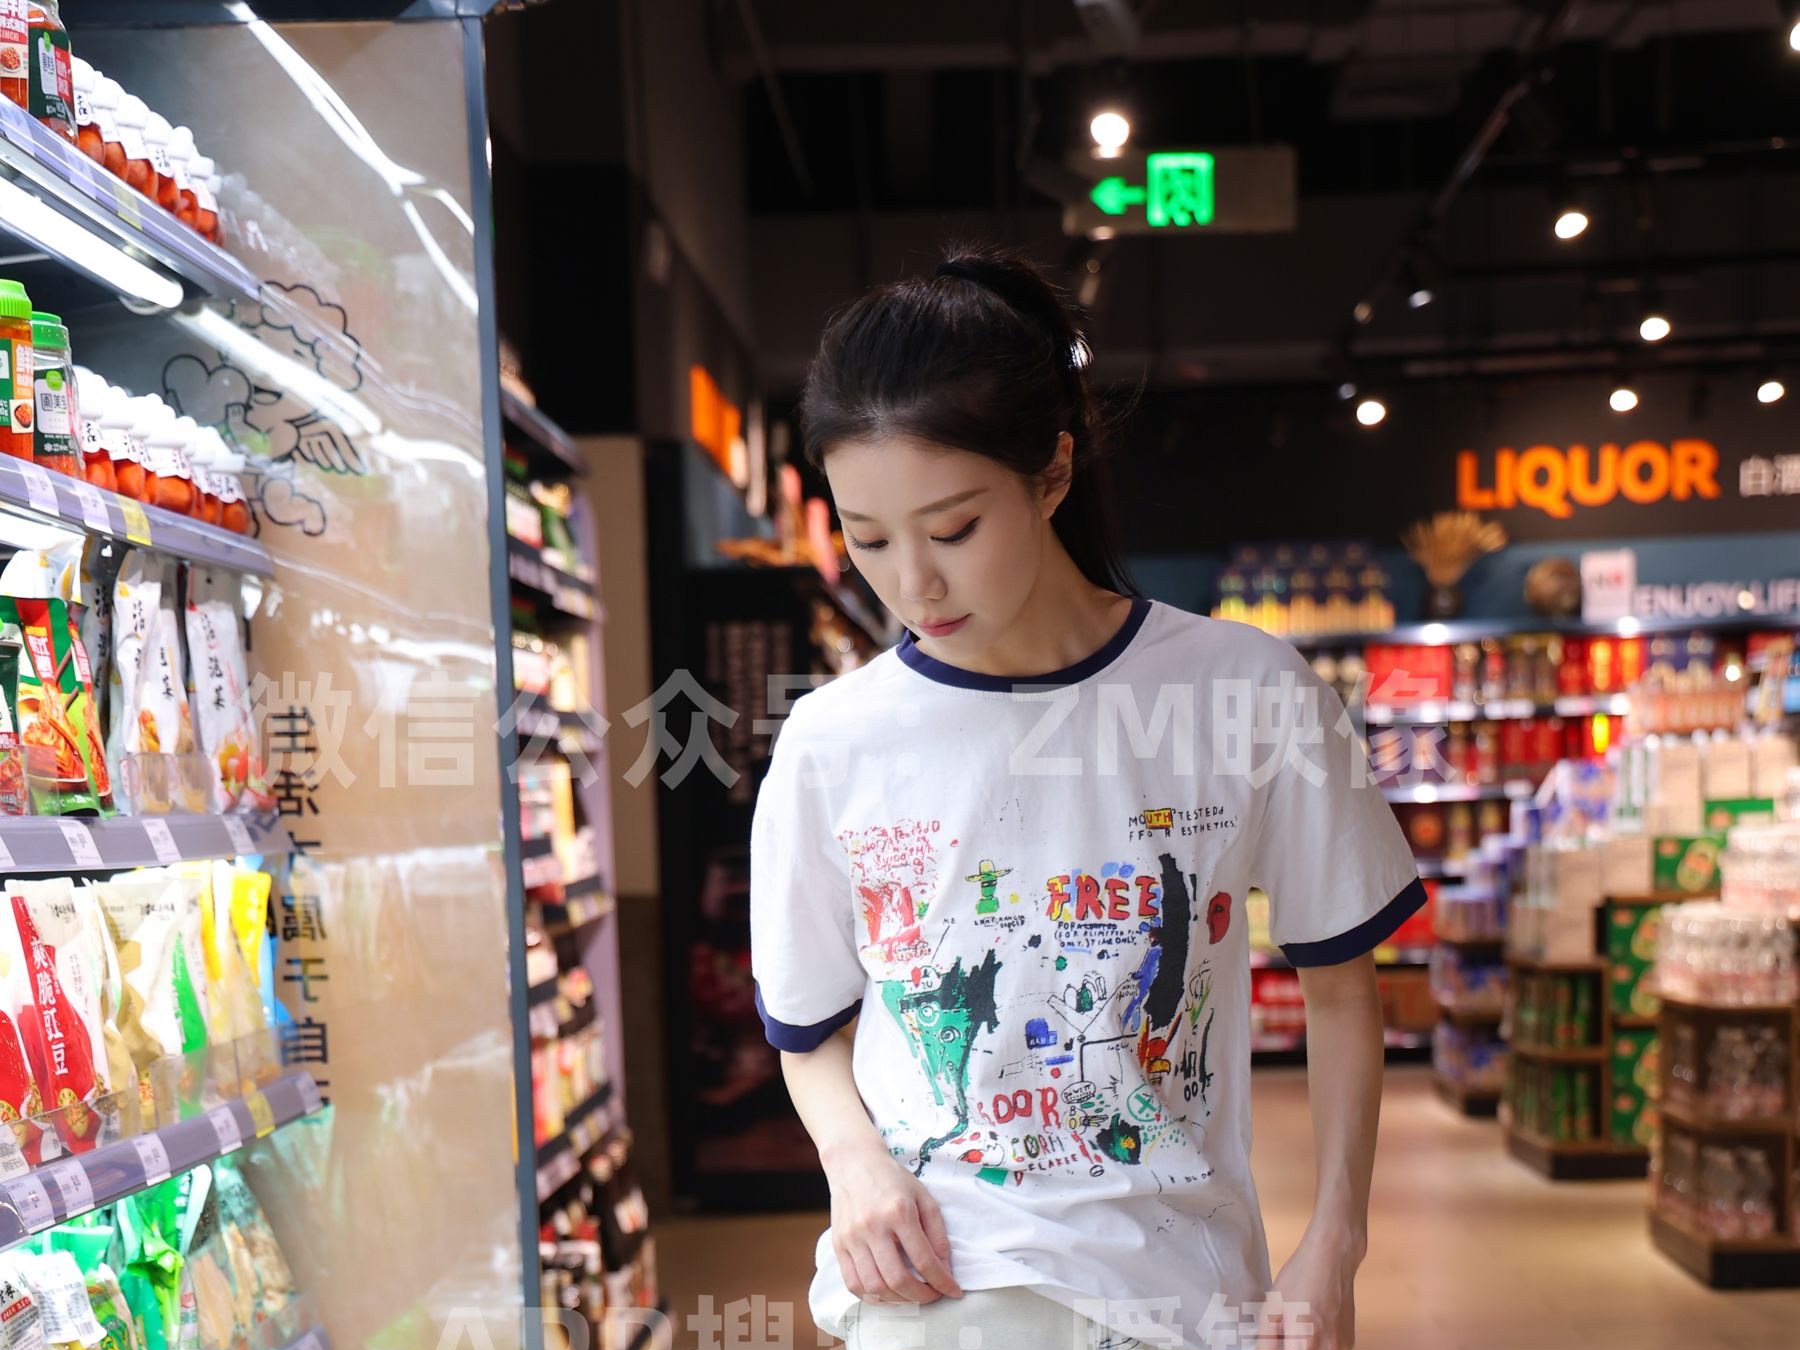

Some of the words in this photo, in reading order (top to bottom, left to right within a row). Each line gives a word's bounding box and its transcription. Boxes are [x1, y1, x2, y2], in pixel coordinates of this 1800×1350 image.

[1457, 439, 1722, 517] LIQUOR
[1633, 582, 1742, 619] ENJOY
[1046, 874, 1160, 921] FREE
[30, 935, 69, 1076] 爽脆豇豆
